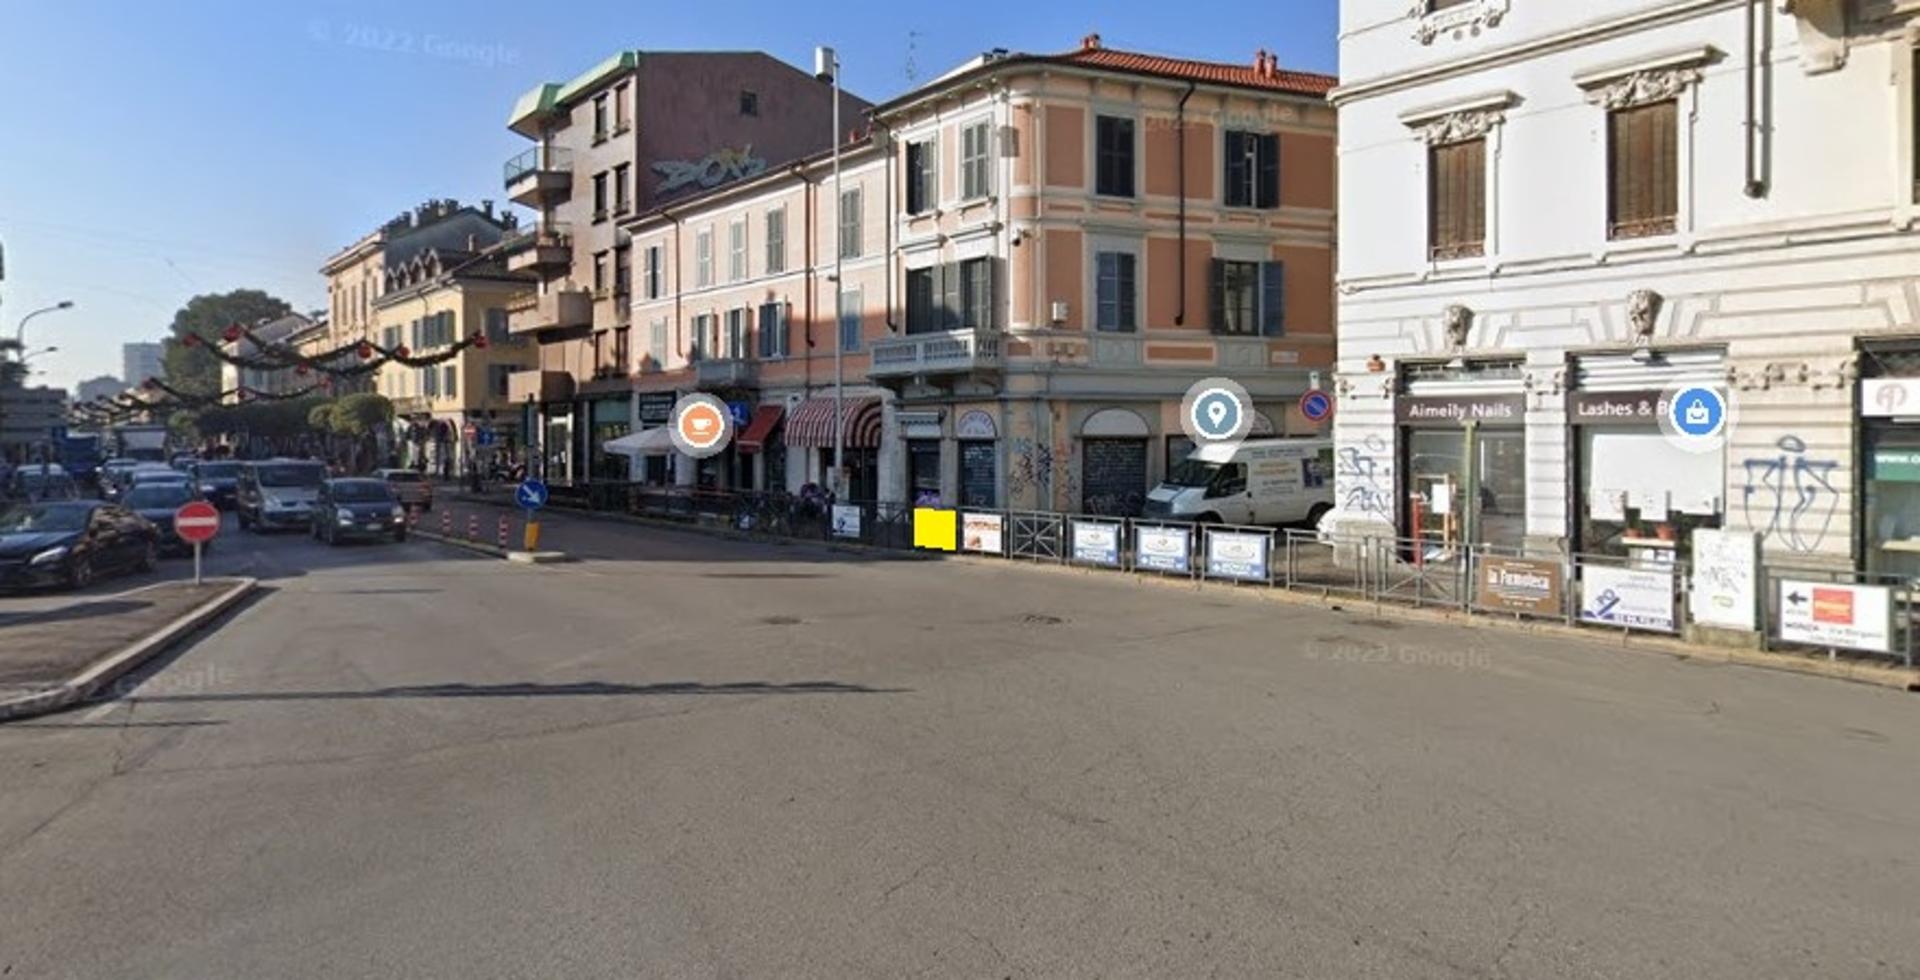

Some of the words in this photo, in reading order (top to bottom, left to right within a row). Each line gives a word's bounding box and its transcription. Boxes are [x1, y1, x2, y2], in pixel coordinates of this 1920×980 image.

[1471, 403, 1512, 418] Nails
[1578, 400, 1633, 416] Lashes
[1637, 400, 1652, 416] &
